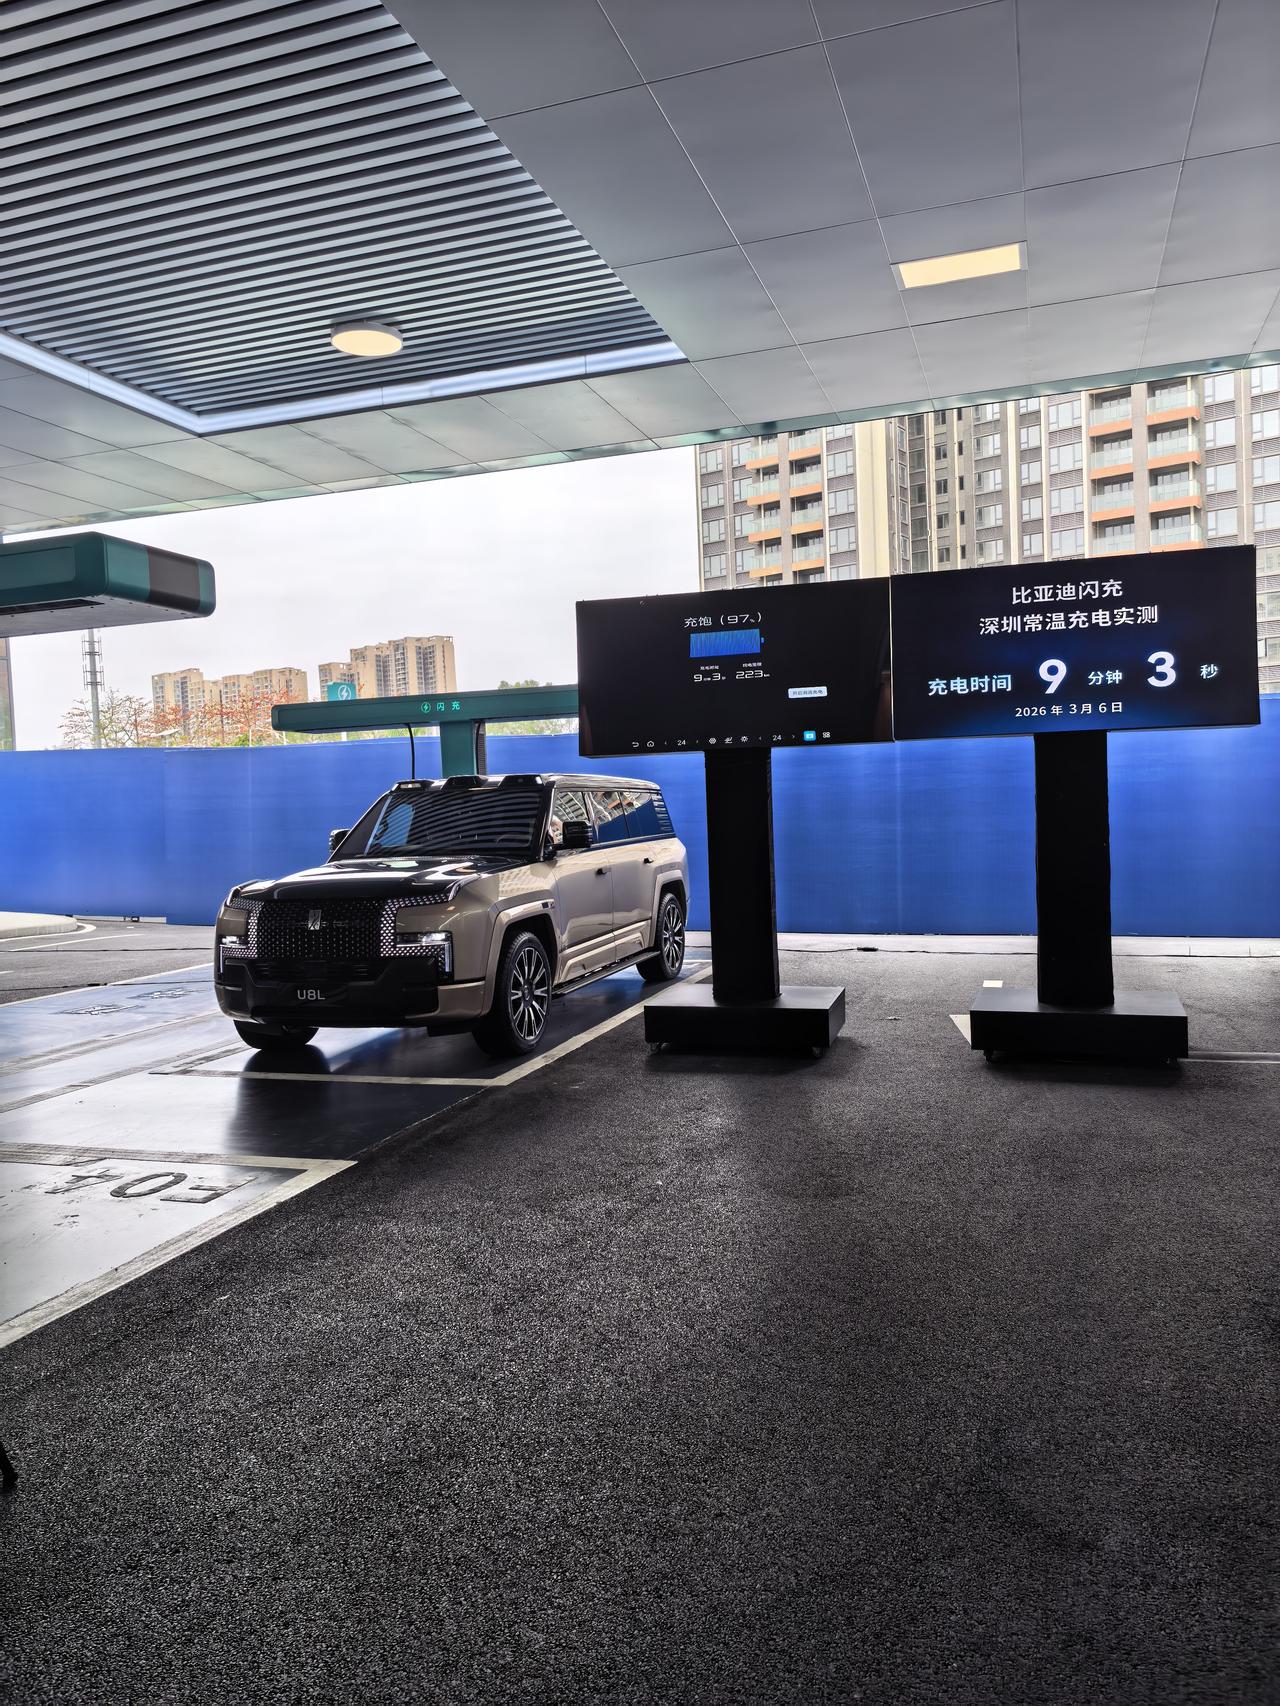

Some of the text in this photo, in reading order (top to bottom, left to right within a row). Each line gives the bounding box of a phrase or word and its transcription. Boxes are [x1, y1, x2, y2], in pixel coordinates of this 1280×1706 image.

[1012, 579, 1123, 605] 比亚迪闪充
[684, 616, 712, 628] 充饱
[979, 605, 1159, 636] 深圳常温充电实测
[928, 651, 1219, 696] 充电时间 9 分钟 3 秒
[436, 701, 461, 711] 闪充
[297, 989, 326, 1001] U8L
